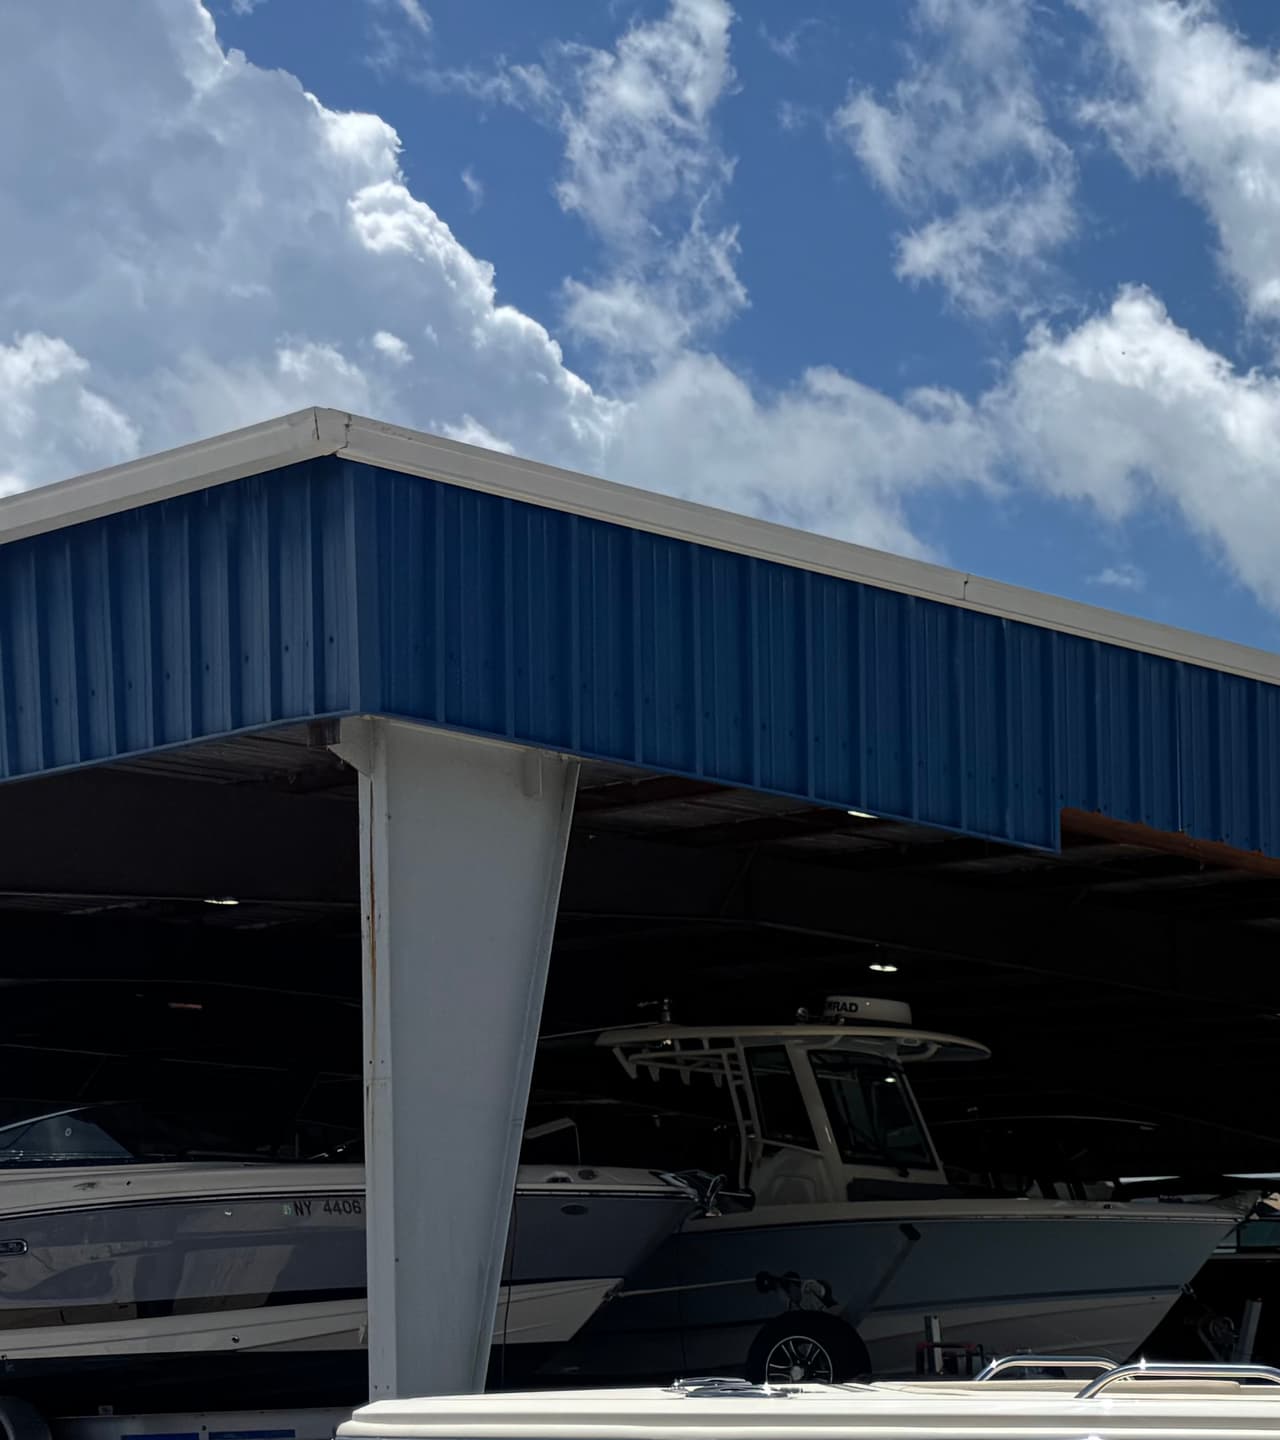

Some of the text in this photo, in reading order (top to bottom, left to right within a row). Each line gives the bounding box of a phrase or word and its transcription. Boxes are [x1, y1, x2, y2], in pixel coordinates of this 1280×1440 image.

[827, 1001, 859, 1013] RAD
[294, 1200, 362, 1216] NY 4406
